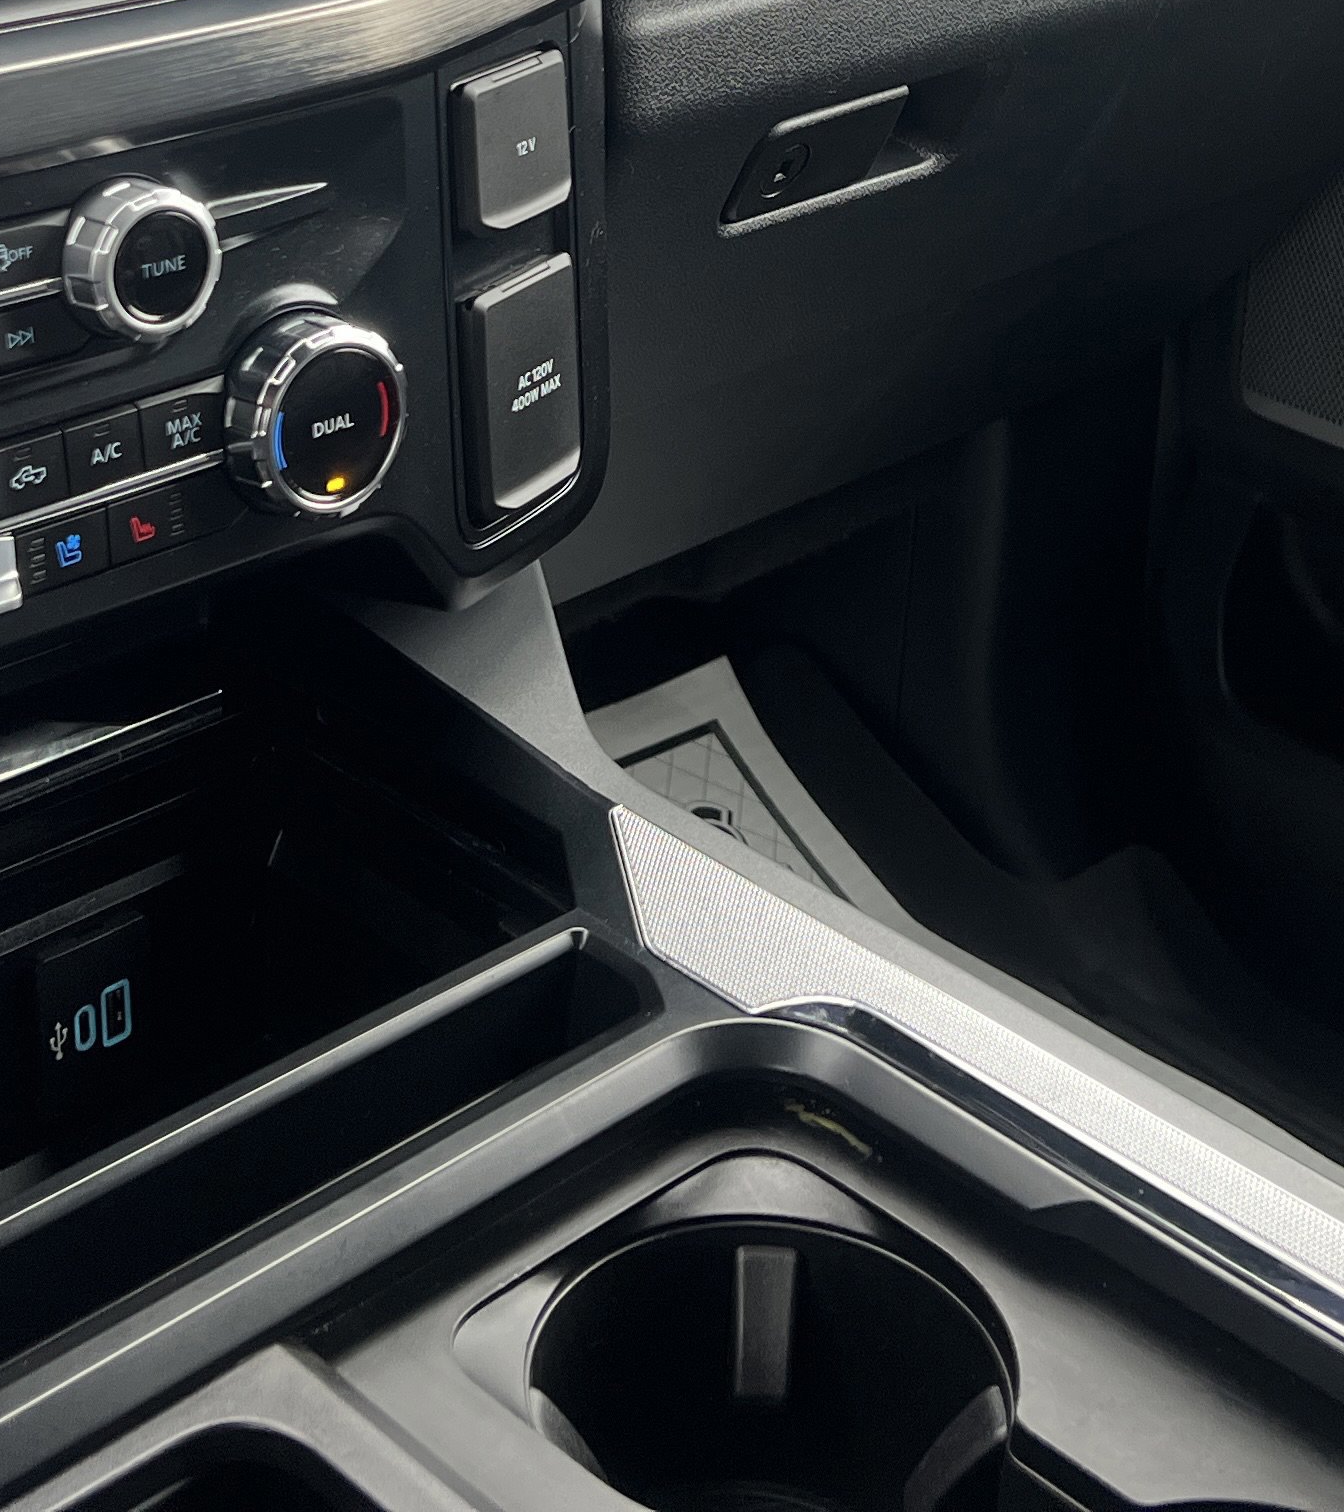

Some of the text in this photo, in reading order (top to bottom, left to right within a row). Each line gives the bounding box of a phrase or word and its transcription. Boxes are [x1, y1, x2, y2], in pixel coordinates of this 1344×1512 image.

[8, 245, 34, 262] OFF
[140, 254, 188, 278] TUNE
[517, 358, 555, 391] AC 120V
[511, 373, 562, 413] 400W MAX
[165, 411, 204, 436] MAX
[311, 413, 356, 439] DUAL
[171, 426, 202, 450] A/C
[90, 441, 123, 466] A/C
